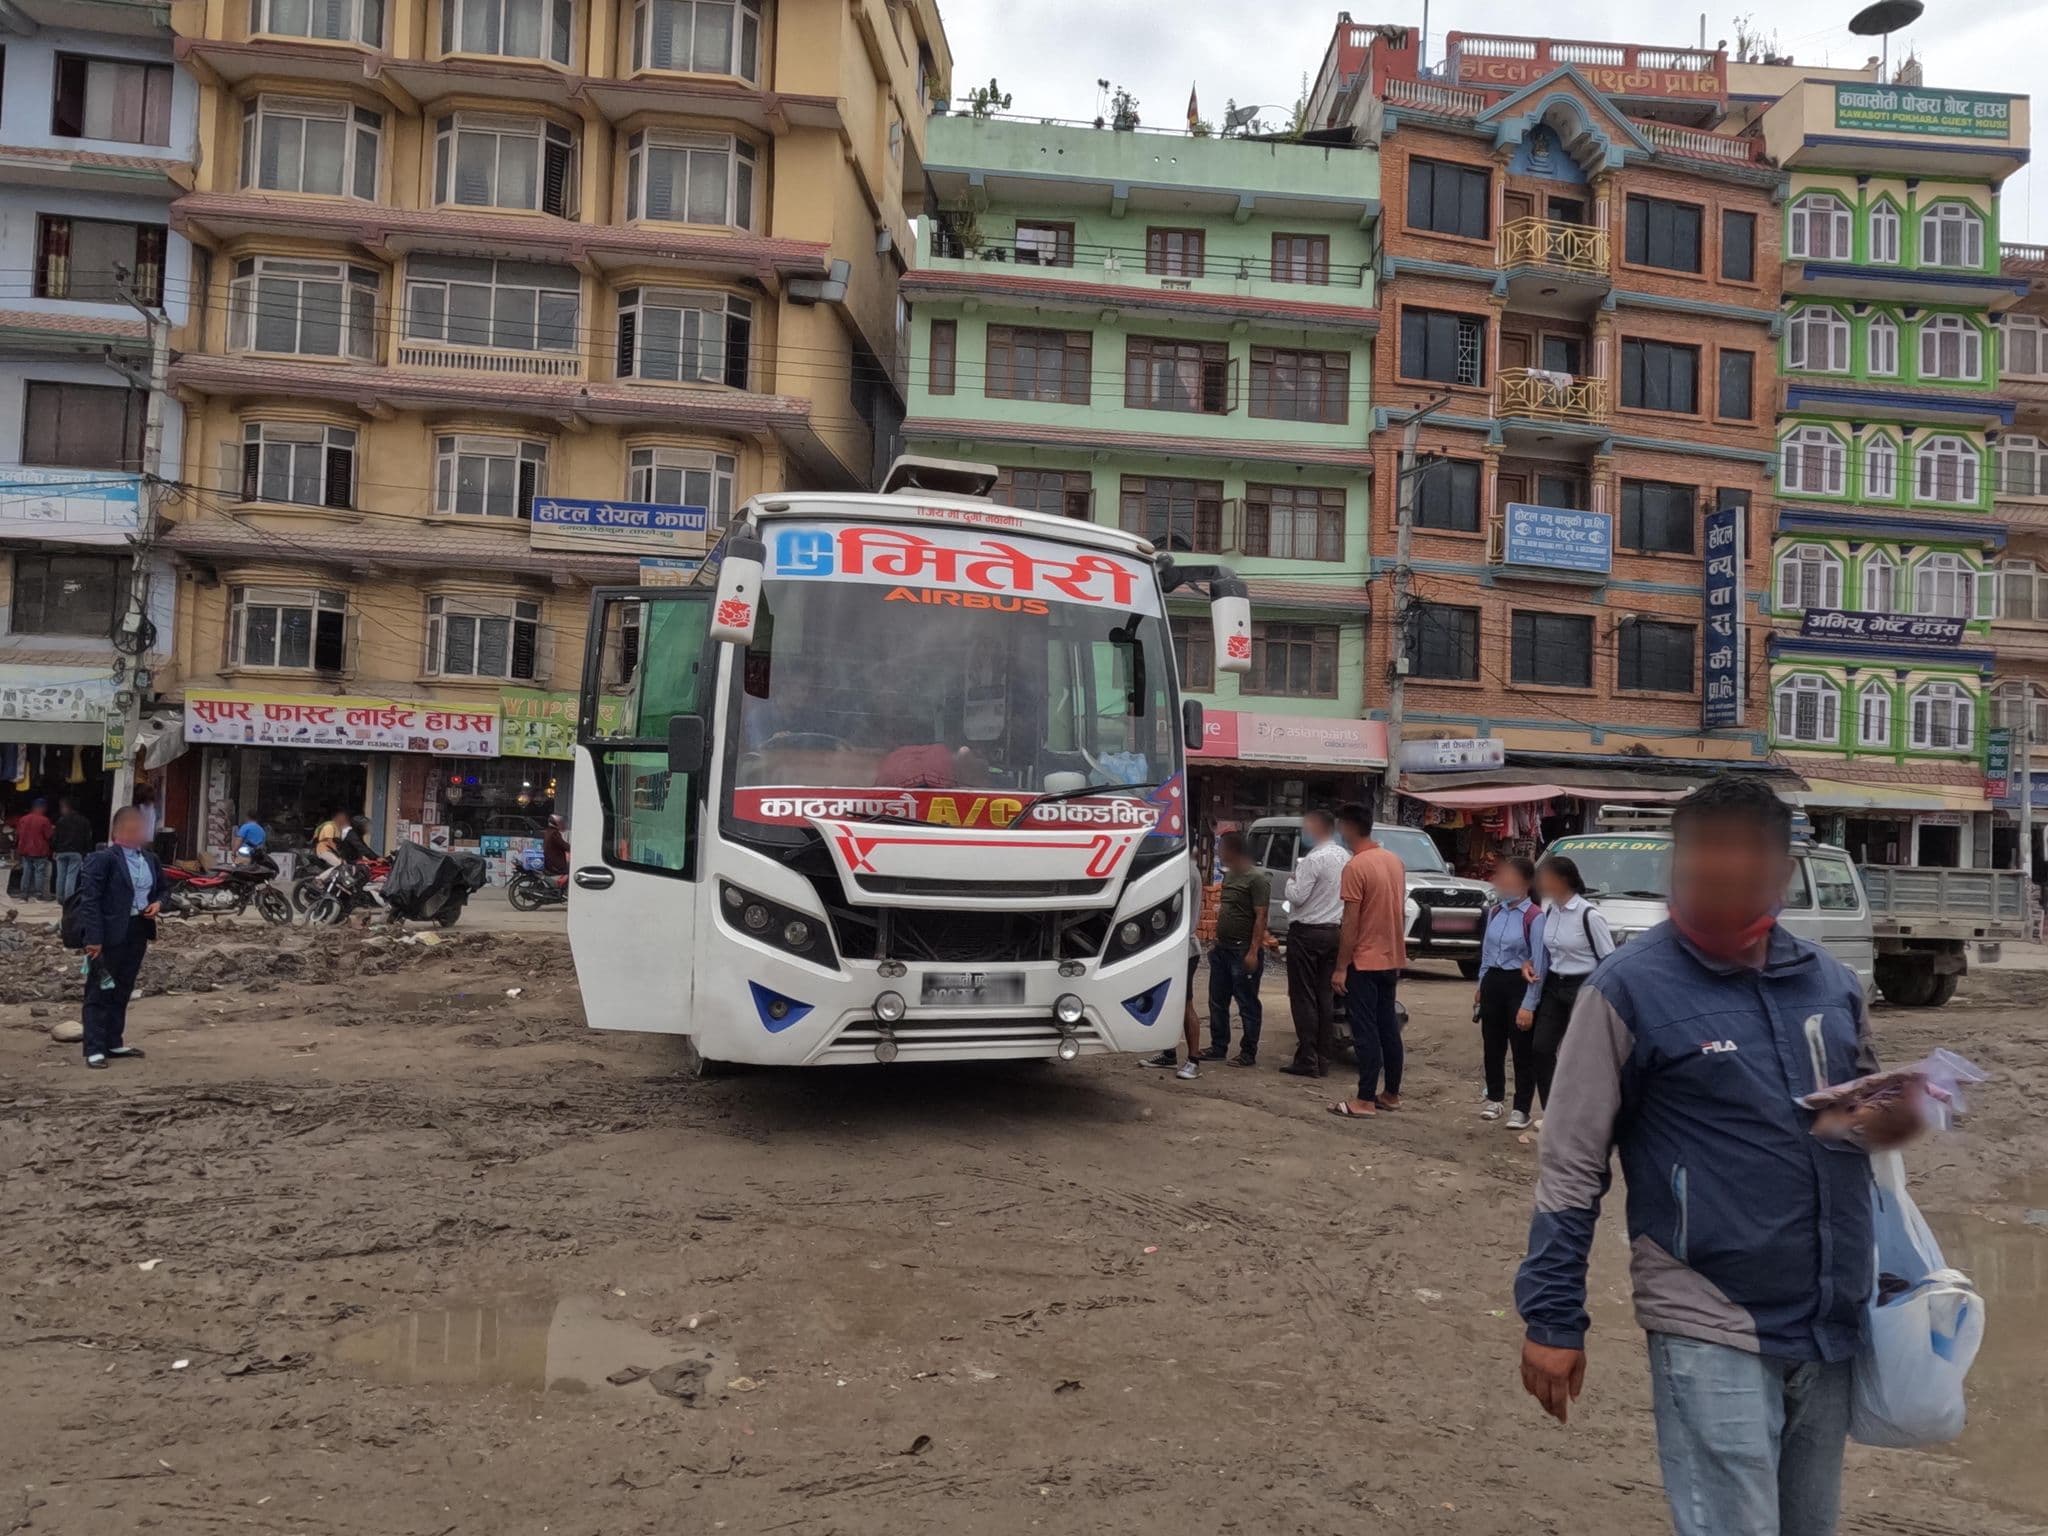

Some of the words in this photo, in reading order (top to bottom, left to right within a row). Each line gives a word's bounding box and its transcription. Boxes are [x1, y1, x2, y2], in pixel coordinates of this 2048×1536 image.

[1839, 109, 1890, 121] KAWASOTI
[1942, 116, 1973, 127] GUEST
[1976, 119, 2008, 129] HOUSE
[539, 501, 590, 521] होटल
[596, 504, 650, 525] रोयल
[655, 510, 705, 529] झापा
[1708, 524, 1733, 549] होटल
[837, 527, 1139, 606] मितेरी
[1709, 554, 1735, 578] न्यू
[884, 586, 1050, 616] AIRBUS
[1869, 616, 1906, 633] गेष्ट
[1910, 622, 1961, 637] हाउस
[192, 699, 254, 724] सुपर
[263, 703, 337, 724] फास्ट
[346, 704, 416, 730] लाईट
[425, 711, 494, 733] हाउस
[502, 696, 562, 720] VIP
[926, 797, 1022, 827] A/C
[1700, 1039, 1738, 1055] FILA
